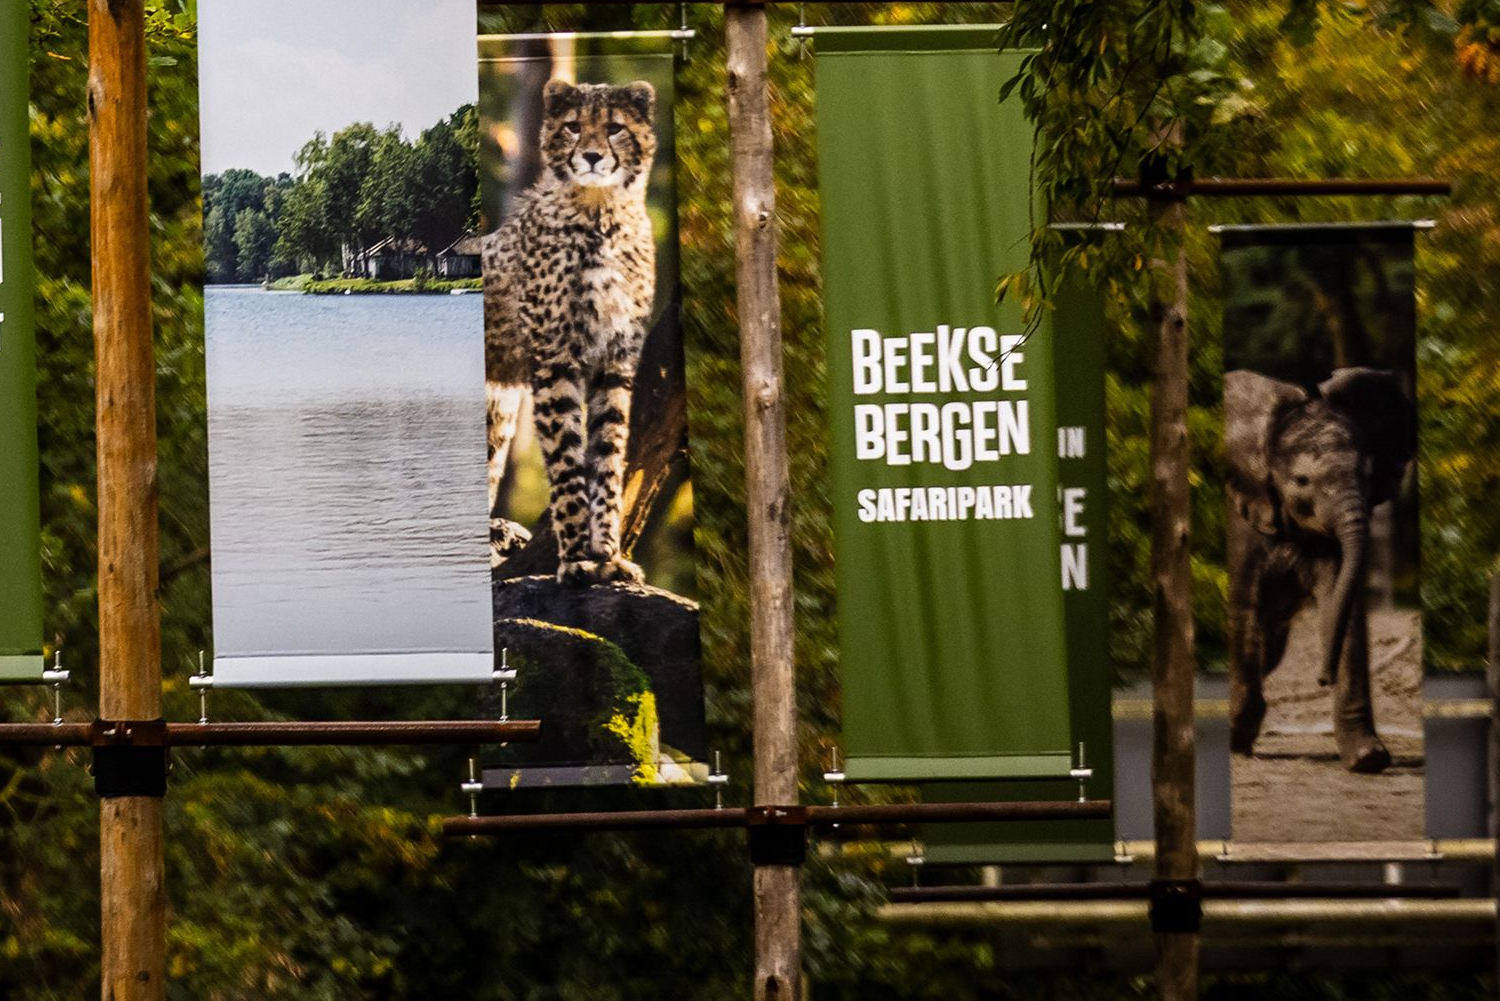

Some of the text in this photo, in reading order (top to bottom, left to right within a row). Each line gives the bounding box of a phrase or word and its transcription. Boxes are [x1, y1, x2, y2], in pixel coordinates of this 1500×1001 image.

[851, 325, 1027, 394] BEEKSE
[854, 401, 1030, 470] BERGEN
[857, 485, 1033, 522] SAFARIPARK
